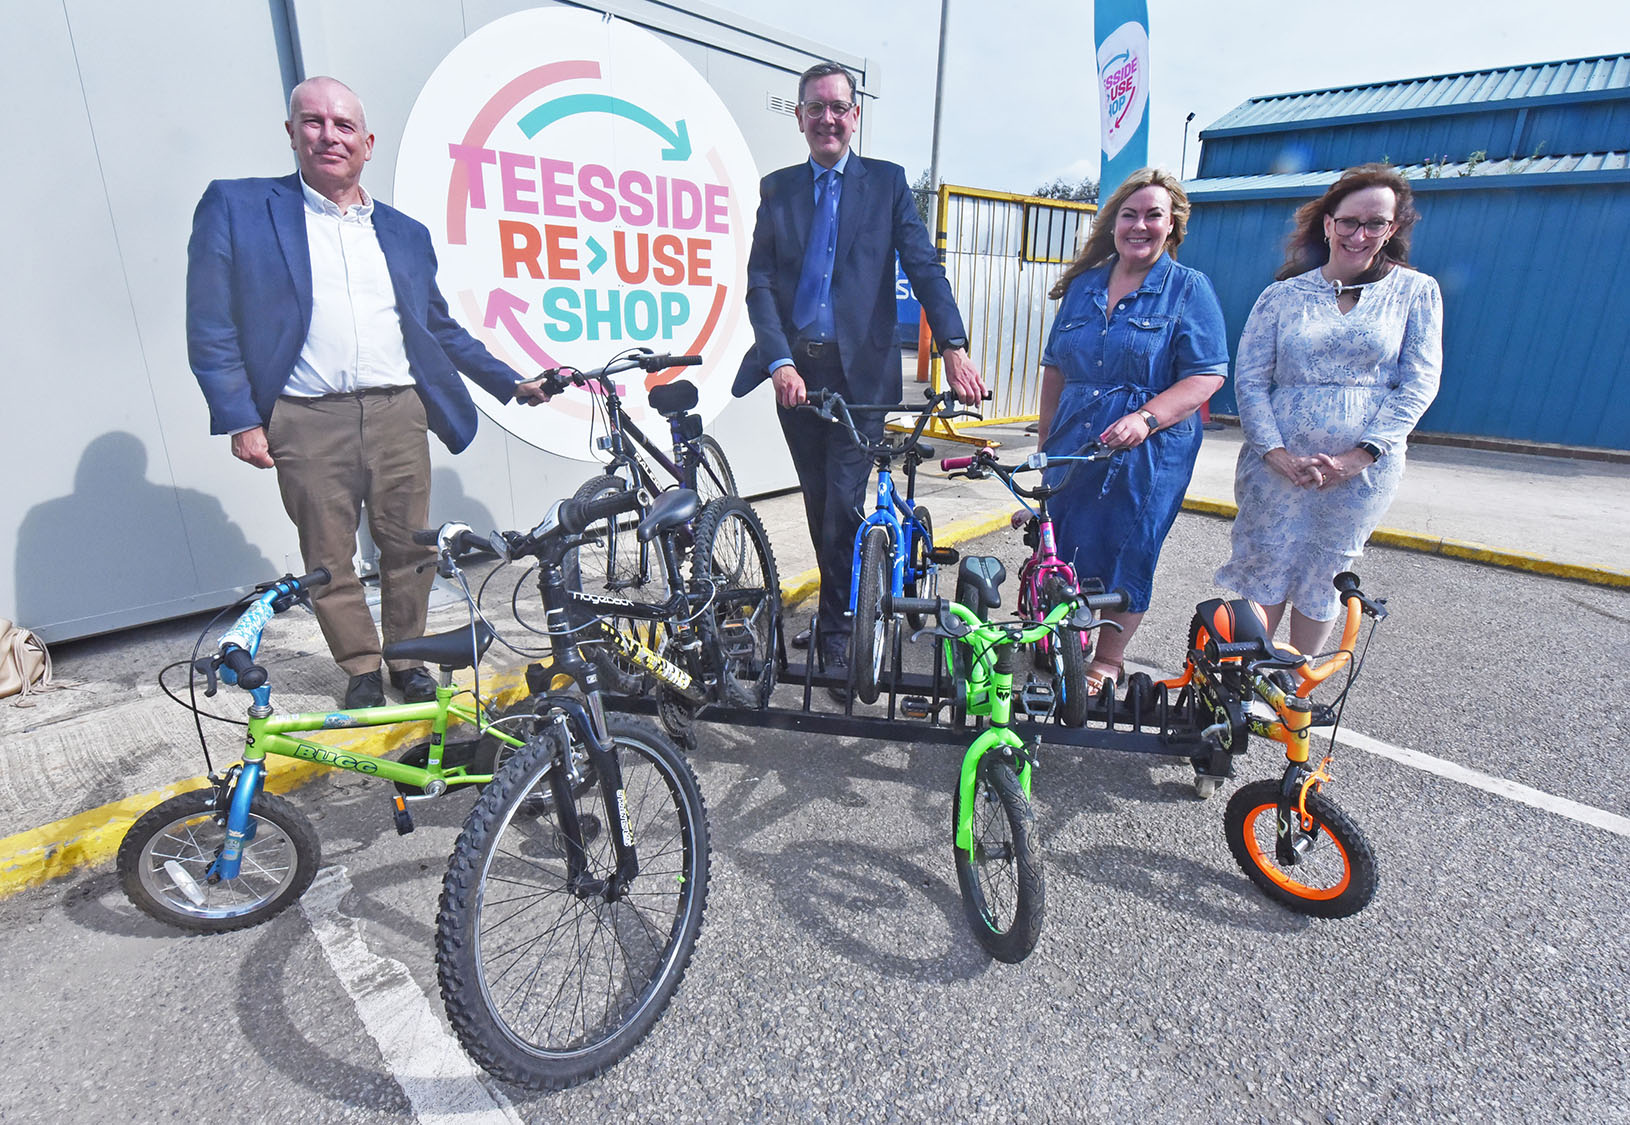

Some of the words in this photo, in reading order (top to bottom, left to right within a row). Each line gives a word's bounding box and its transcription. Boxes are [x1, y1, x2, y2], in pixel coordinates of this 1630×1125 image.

[1111, 76, 1133, 101] USE
[448, 143, 729, 234] TEESSIDE
[542, 286, 691, 343] SHOP
[294, 744, 378, 774] BUGG
